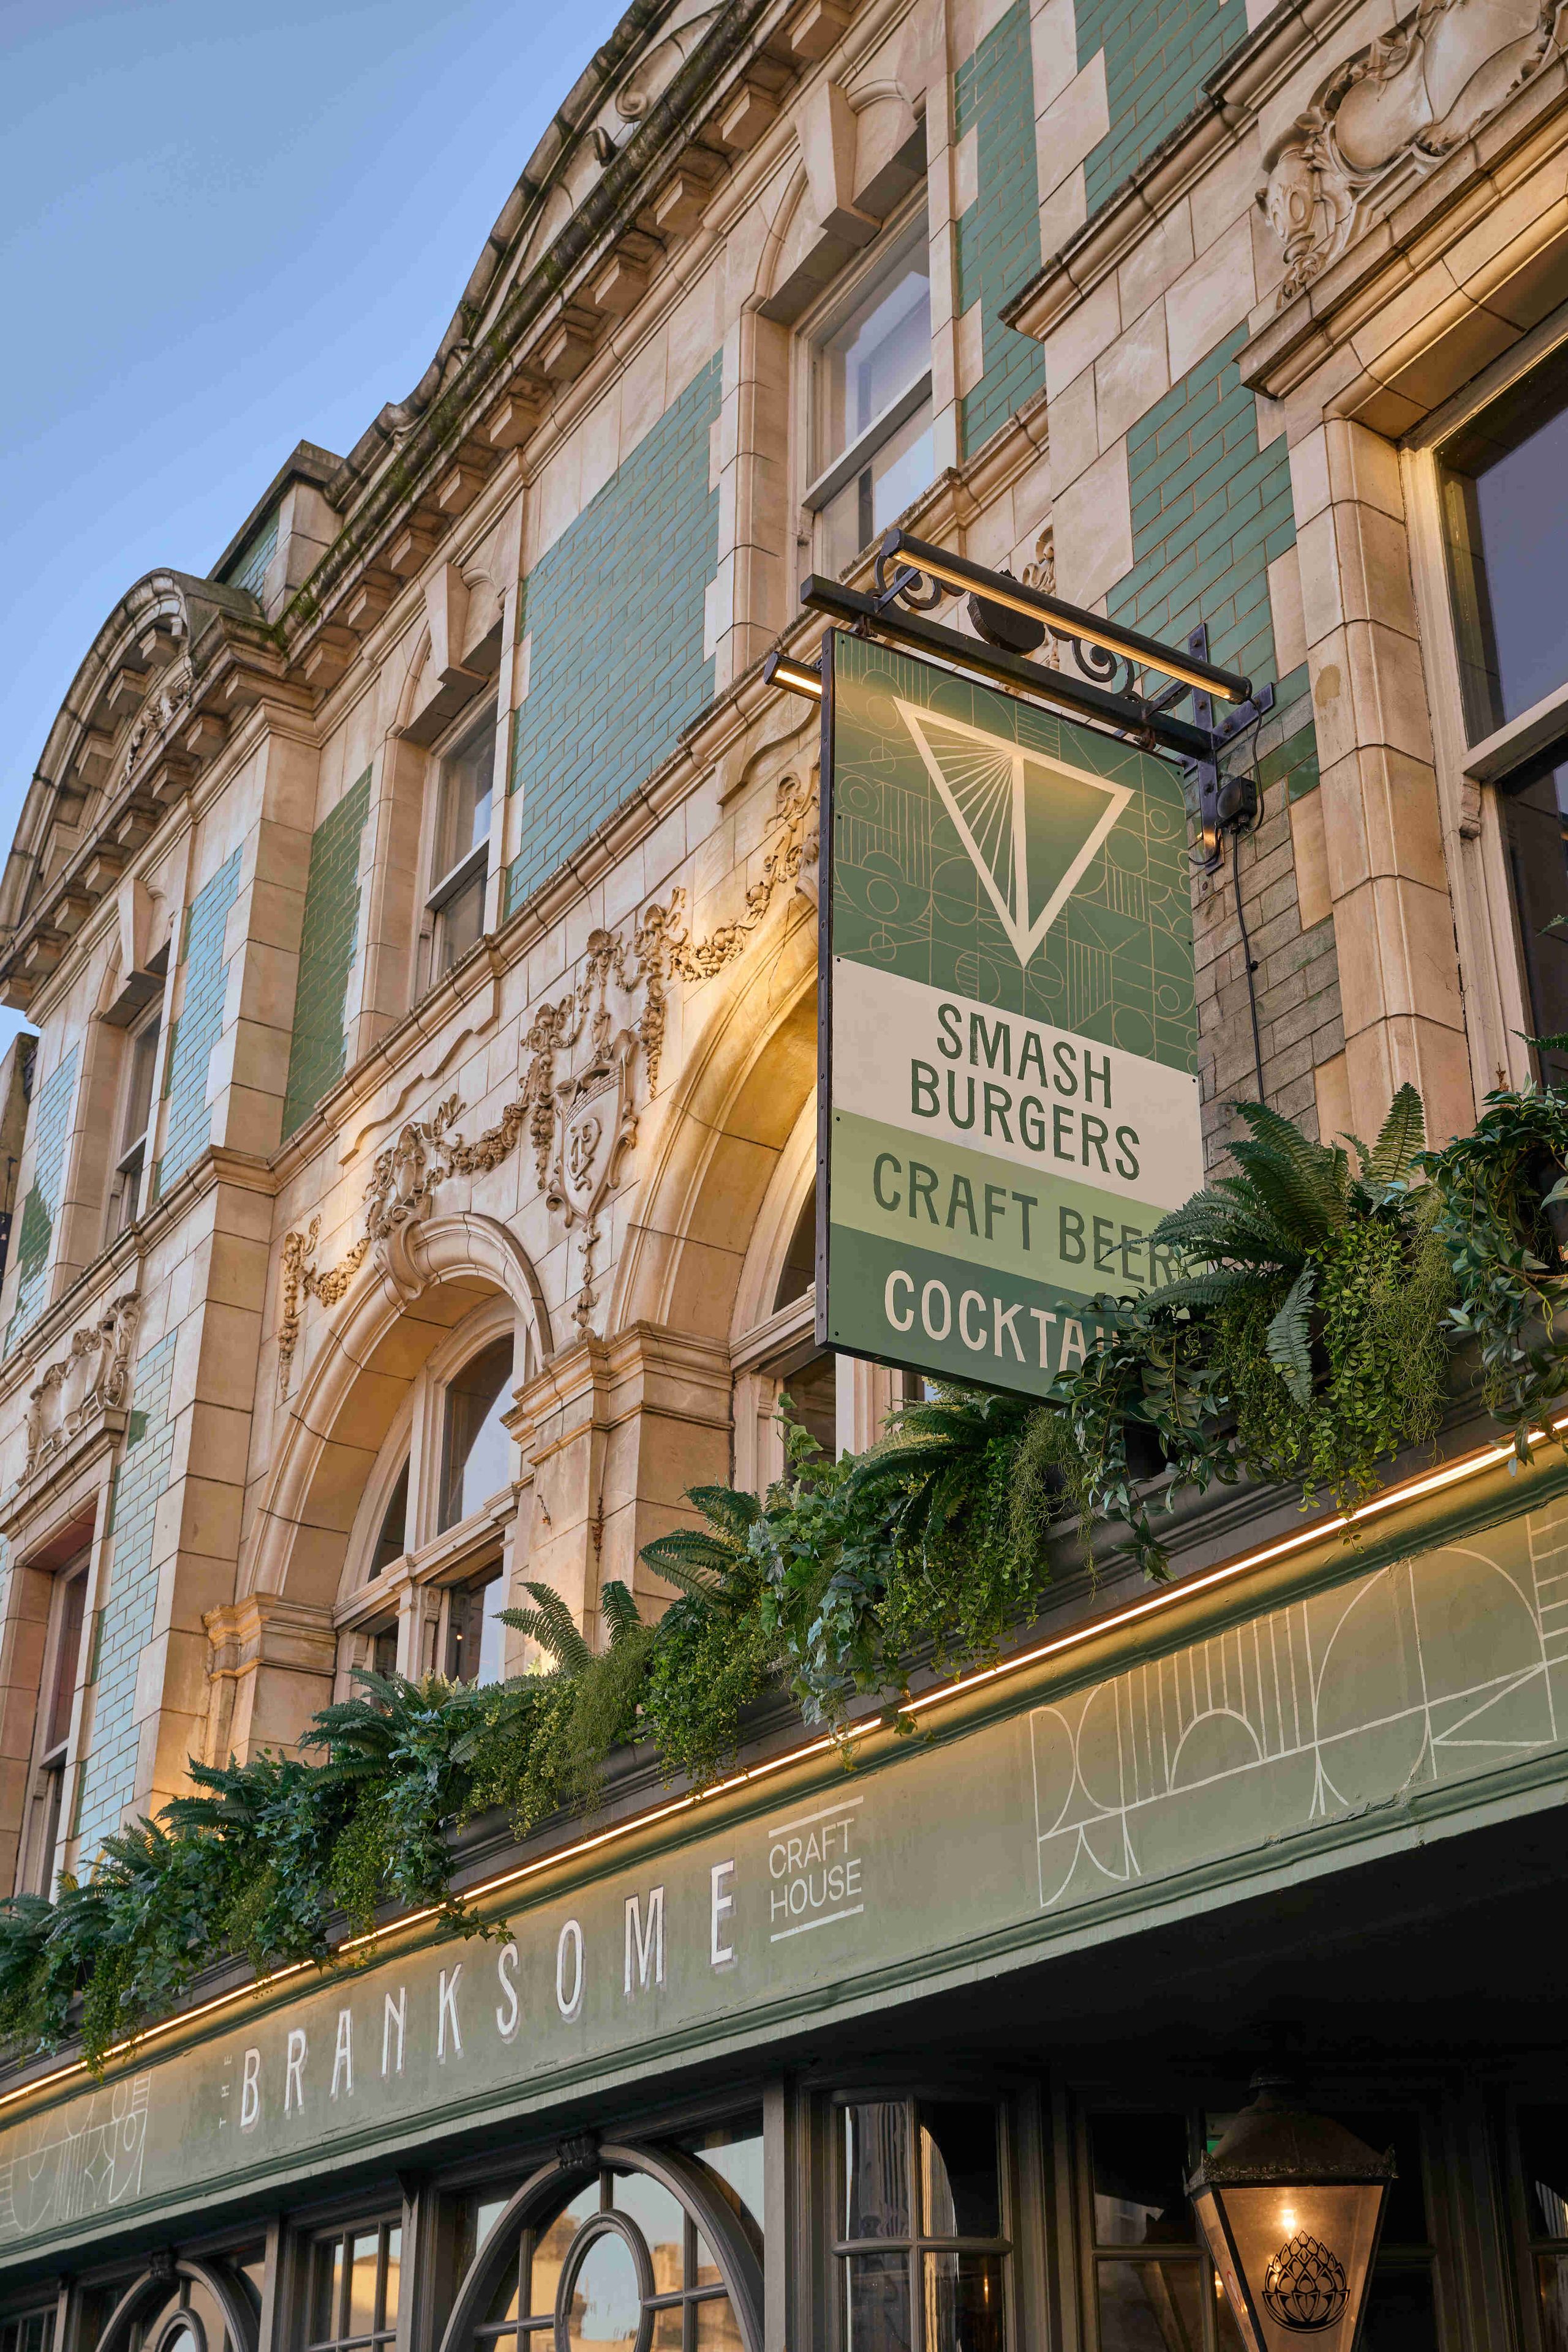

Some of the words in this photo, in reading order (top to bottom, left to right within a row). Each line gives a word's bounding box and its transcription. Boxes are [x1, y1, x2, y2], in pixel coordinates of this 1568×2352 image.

[937, 1003, 1112, 1109] SMASH
[911, 1058, 1140, 1180] BURGERS
[873, 1152, 1038, 1251] CRAFT
[1059, 1205, 1175, 1287] BEER
[884, 1270, 1121, 1372] COCKTA
[769, 1818, 854, 1879] CRAFT
[769, 1858, 861, 1923] HOUSE
[240, 1860, 734, 2127] BRANKSOME
[219, 2054, 233, 2129] THE
